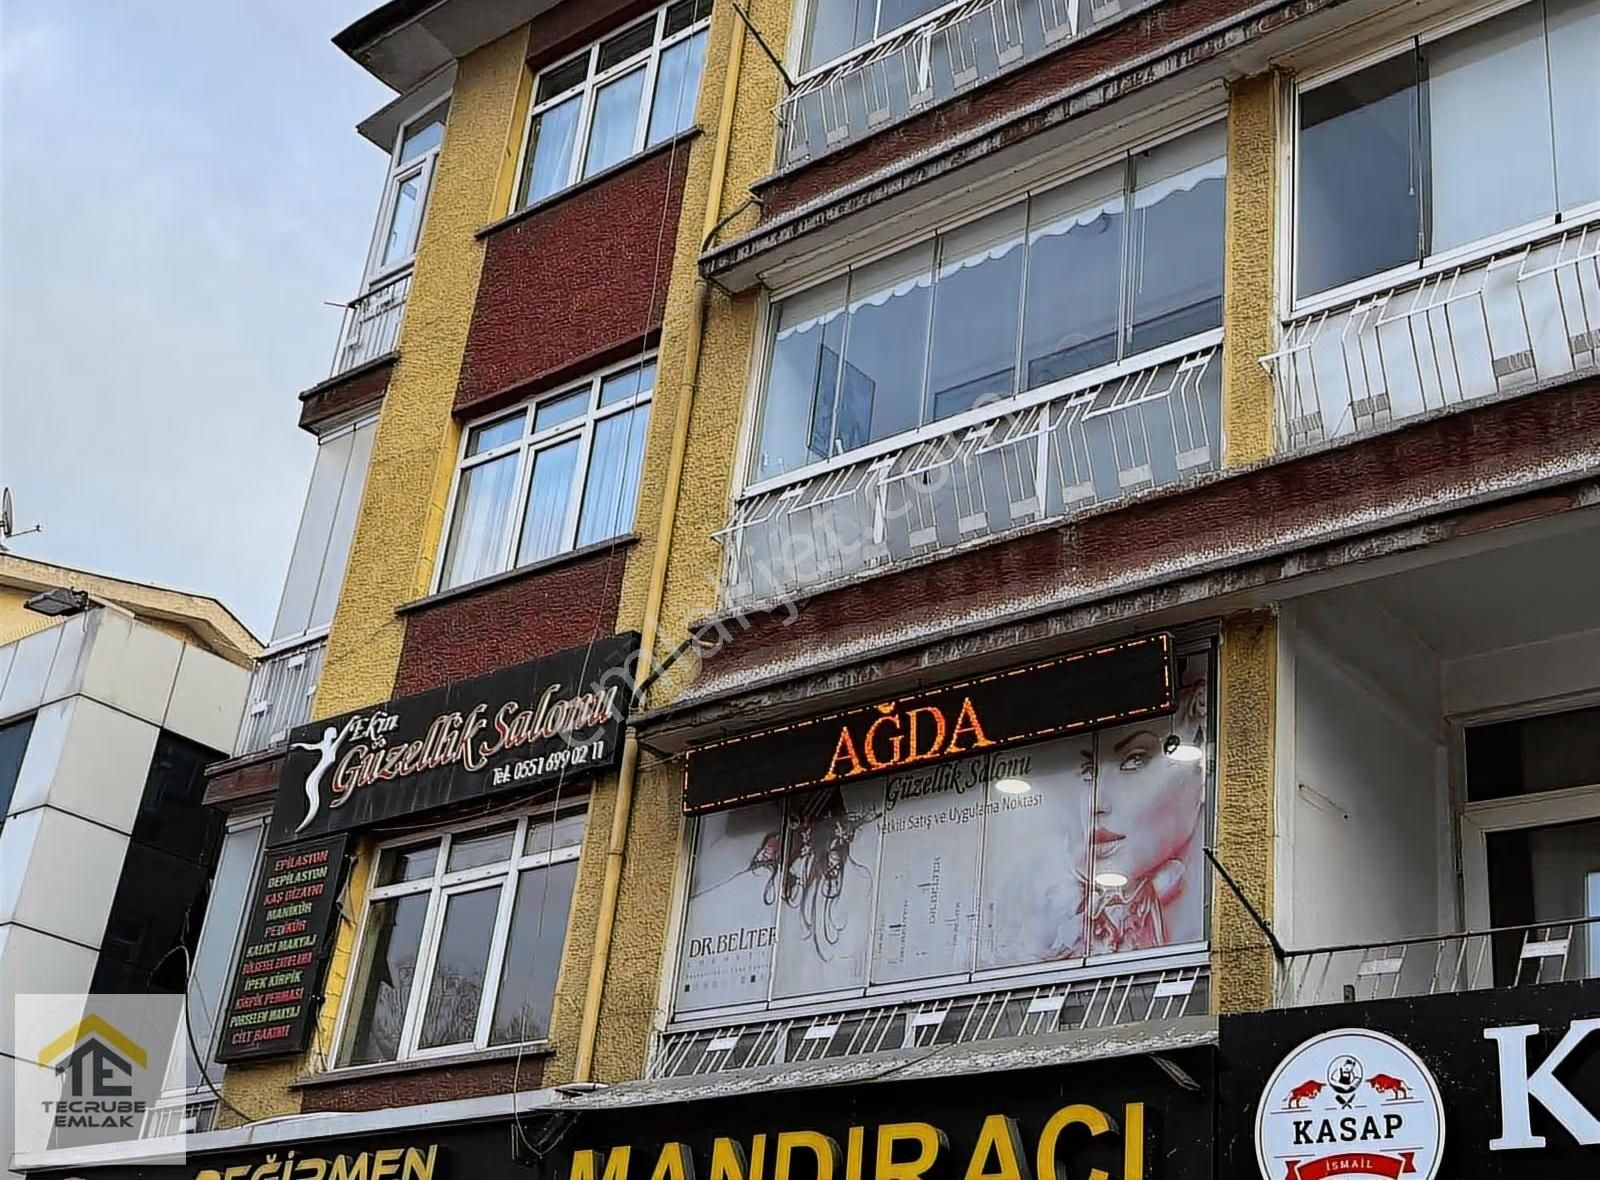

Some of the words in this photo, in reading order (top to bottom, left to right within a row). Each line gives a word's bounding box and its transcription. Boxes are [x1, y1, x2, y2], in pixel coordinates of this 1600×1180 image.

[330, 703, 488, 808] Güzellik
[479, 683, 618, 756] Salonu
[821, 697, 997, 784] AĞDA
[514, 757, 545, 780] 0551
[546, 749, 571, 772] 699
[571, 745, 588, 765] 02
[592, 741, 604, 760] 11
[885, 762, 965, 811] Güzellik
[965, 752, 1032, 789] Salonu
[908, 812, 932, 830] Satış
[935, 811, 946, 824] ve
[1483, 1018, 1600, 1151] K
[1293, 1114, 1403, 1145] KASAP
[195, 1144, 438, 1180] ĞİRMEN
[1326, 1158, 1373, 1171] İSMAİL
